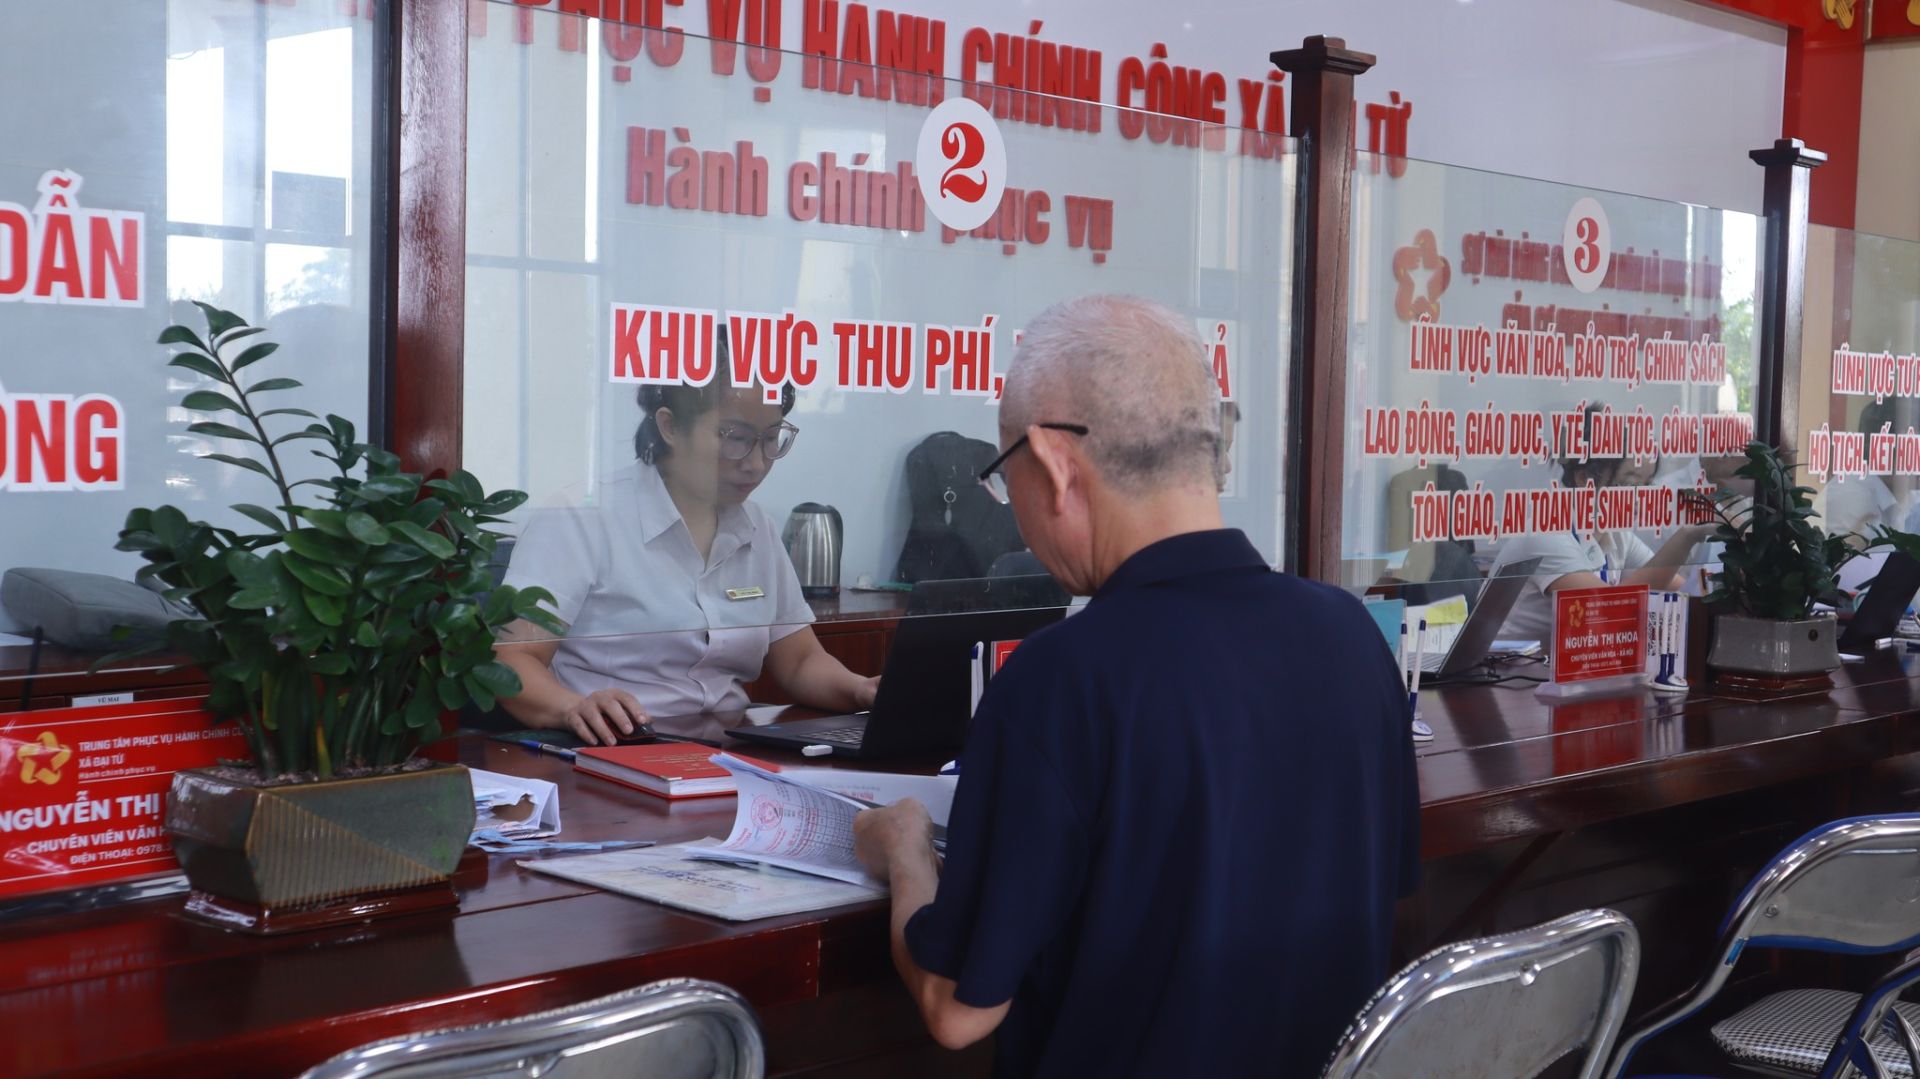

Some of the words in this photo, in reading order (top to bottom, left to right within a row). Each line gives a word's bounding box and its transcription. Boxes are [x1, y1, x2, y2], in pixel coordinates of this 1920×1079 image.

[707, 0, 782, 102] VỤ
[962, 20, 1102, 133] CHÍNH
[1117, 43, 1226, 151] CÔNG
[1238, 69, 1286, 161] XÃ
[1365, 91, 1412, 178] TỪ
[626, 126, 768, 217] Hành
[789, 151, 925, 232] chính
[940, 122, 988, 203] 2
[1574, 217, 1600, 273] 3
[614, 308, 713, 381] KHU
[730, 313, 818, 400] VỰC
[833, 322, 912, 388] THU
[925, 316, 1003, 400] PHÍ,
[1411, 315, 1452, 370] LĨNH
[1458, 326, 1491, 383] VỰC
[1496, 322, 1529, 375] VĂN
[1533, 324, 1569, 383] HÓA,
[1575, 322, 1605, 378] BẢO
[1610, 334, 1641, 389] TRỢ,
[1645, 332, 1686, 381] CHÍNH
[1691, 335, 1725, 382] SÁCH
[1834, 345, 1865, 392] LĨNH
[1868, 352, 1895, 403] VỰC
[1898, 355, 1916, 394] TƯ
[0, 399, 118, 484] NG
[1365, 409, 1400, 454] LAO
[1405, 400, 1460, 467] ĐỘNG,
[1465, 402, 1505, 455] GIÁO
[1509, 413, 1548, 466] DỤC,
[1552, 414, 1562, 454] Y
[1566, 400, 1588, 461] TẾ,
[1592, 405, 1624, 454] DÂN
[1627, 406, 1659, 464] TỘC,
[1661, 406, 1698, 454] CÔNG
[1809, 424, 1830, 481] HỘ
[1833, 434, 1867, 481] TỊCH,
[1870, 422, 1895, 471] KẾT
[1414, 483, 1448, 539] TÔN
[1454, 483, 1498, 541] GIÁO,
[1502, 492, 1526, 533] AN
[1531, 481, 1572, 532] TOÀN
[1577, 480, 1595, 540] VỆ
[1598, 490, 1633, 529] SINH
[1638, 485, 1672, 535] THỰC
[1565, 628, 1599, 649] NGUYỄN
[1601, 633, 1615, 648] THỊ
[1616, 631, 1639, 645] KHOA
[78, 741, 111, 752] TRUNG
[112, 737, 131, 748] TÂM
[132, 734, 159, 748] PHỤC
[160, 733, 173, 745] VỤ
[174, 729, 200, 742] HÀNH
[0, 790, 110, 832] NGUYỄN
[116, 792, 160, 820] THỊ
[27, 833, 89, 855] CHUYÊN
[90, 828, 124, 846] VIÊN
[126, 825, 158, 841] VĂN
[70, 853, 96, 865] ĐIỆN
[99, 849, 133, 860] THOẠI:
